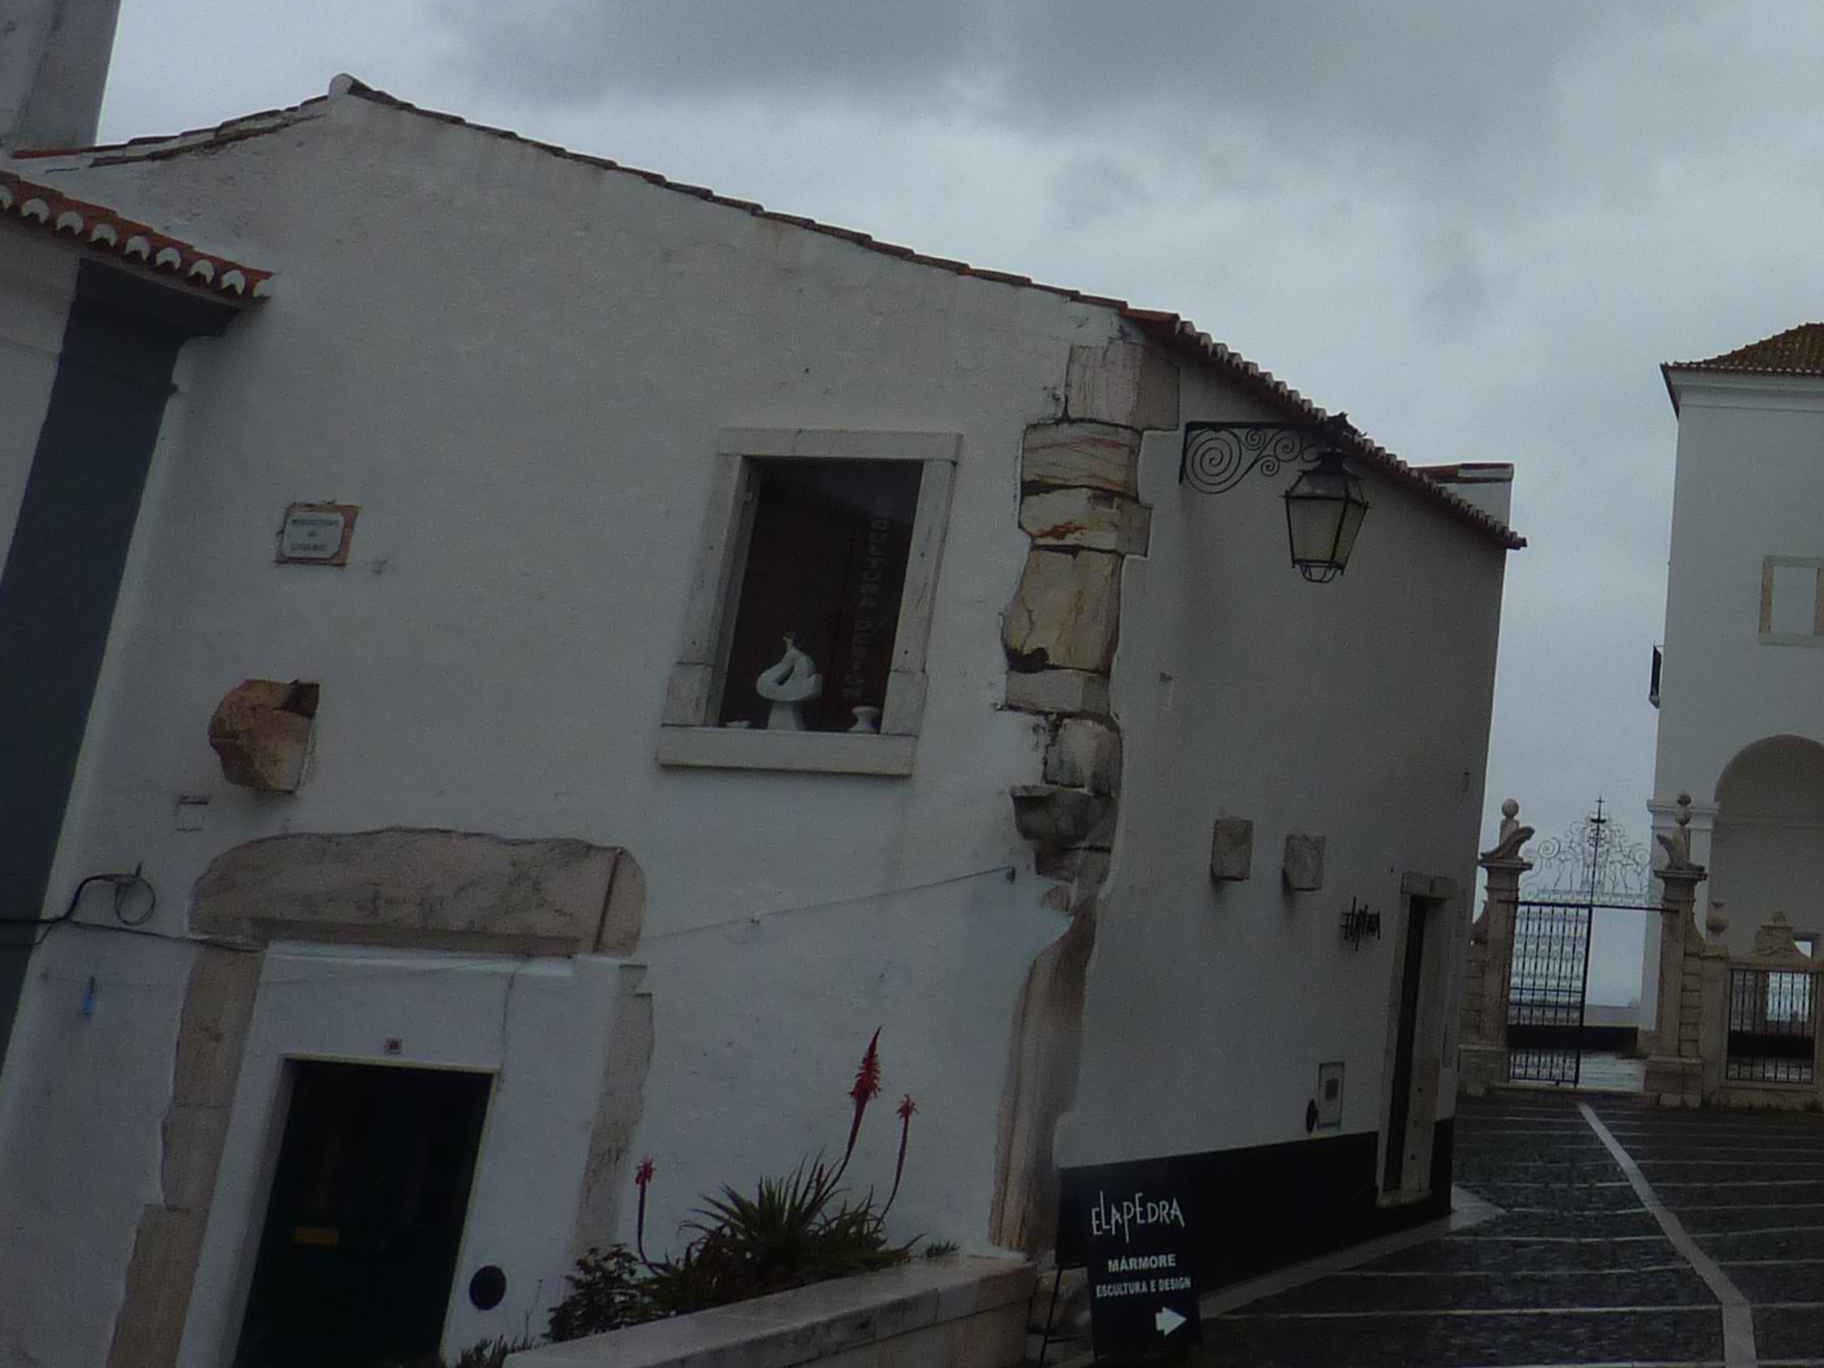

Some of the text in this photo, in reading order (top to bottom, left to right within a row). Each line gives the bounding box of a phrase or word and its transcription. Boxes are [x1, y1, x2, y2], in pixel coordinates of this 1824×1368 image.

[1108, 1254, 1176, 1273] MÁRMORE
[1096, 1276, 1192, 1298] ESCULTURA E DESIGN
